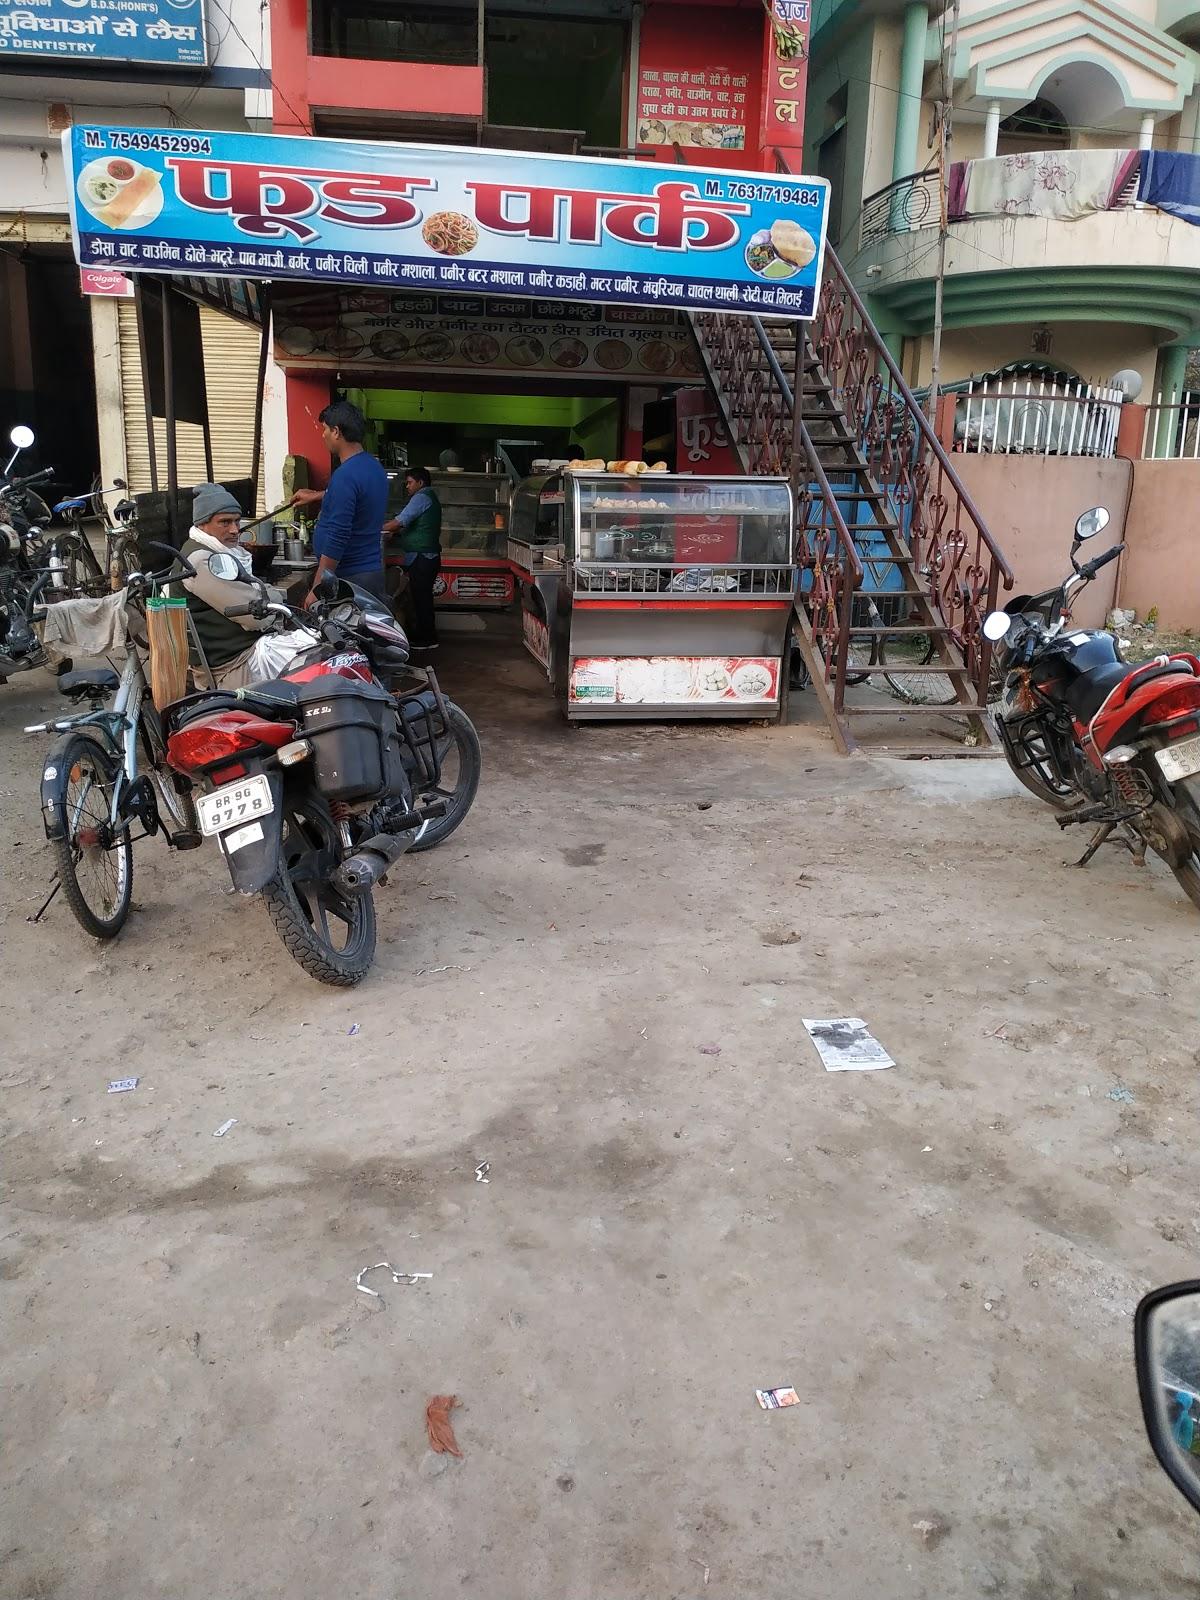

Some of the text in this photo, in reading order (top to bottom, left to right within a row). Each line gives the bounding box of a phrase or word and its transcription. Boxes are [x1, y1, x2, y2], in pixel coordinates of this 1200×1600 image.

[111, 17, 139, 37] से
[12, 39, 96, 52] DENTISTRY
[661, 102, 675, 114] दही
[678, 105, 688, 115] का
[731, 107, 738, 119] है
[85, 131, 212, 154] M. 7549452994
[705, 180, 820, 206] M. 7631719484
[165, 157, 751, 252] फूड पार्क
[87, 274, 122, 284] Colgate
[239, 252, 257, 266] पाव
[315, 254, 342, 274] पनीर
[373, 256, 400, 278] पनीर
[440, 263, 466, 282] पनीर
[467, 268, 489, 284] बटर
[529, 270, 554, 289] पनीर
[590, 277, 612, 293] मटर
[688, 284, 713, 299] चावल
[742, 285, 761, 303] रोटी
[762, 287, 775, 304] एवं
[776, 288, 803, 308] मिठाई
[481, 321, 504, 332] का
[665, 330, 687, 341] पर
[215, 788, 251, 809] BR 9G
[211, 798, 262, 826] 9778
